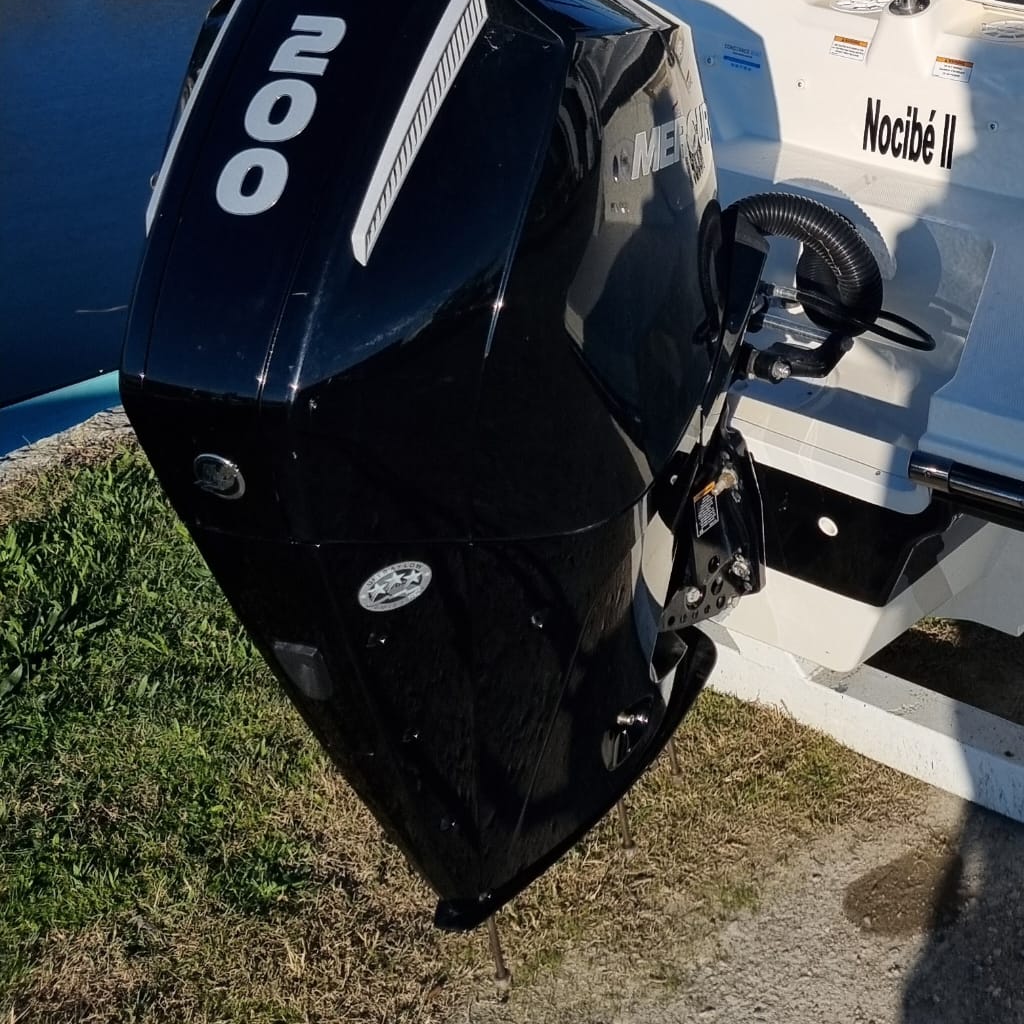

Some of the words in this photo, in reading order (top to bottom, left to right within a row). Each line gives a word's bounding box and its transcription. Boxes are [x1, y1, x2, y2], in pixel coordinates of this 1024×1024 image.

[215, 14, 347, 216] 200
[631, 103, 711, 180] MERCUR
[862, 97, 937, 165] Nocibé
